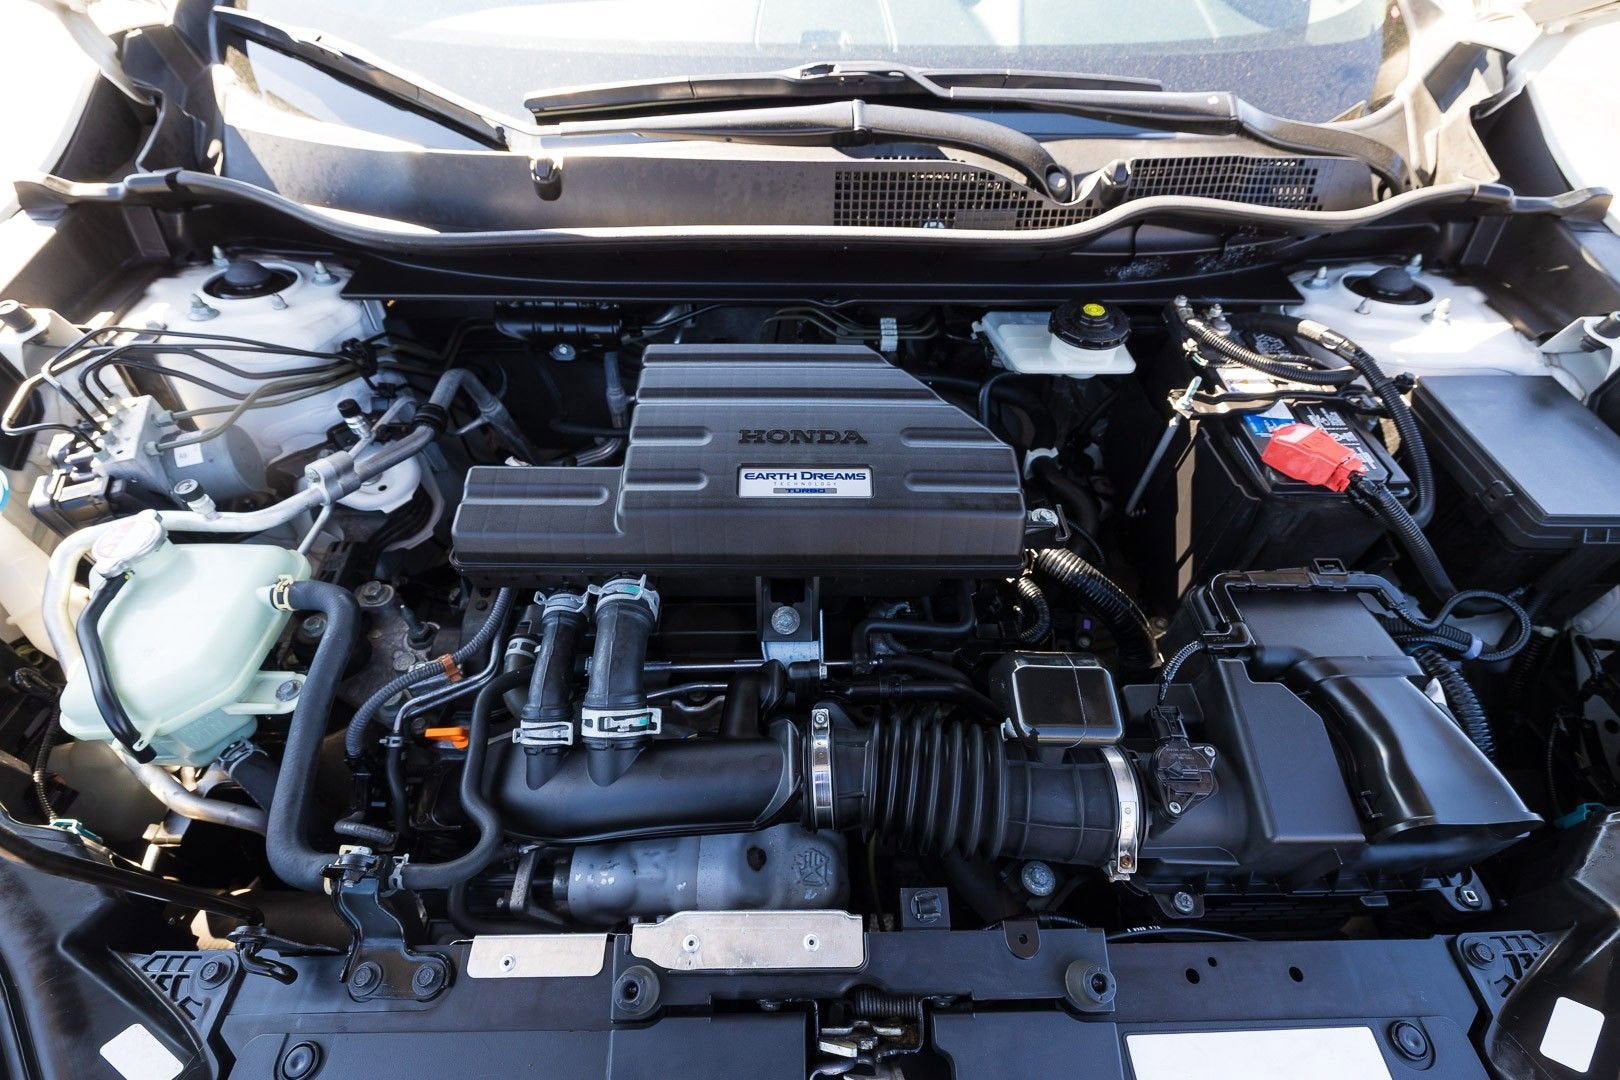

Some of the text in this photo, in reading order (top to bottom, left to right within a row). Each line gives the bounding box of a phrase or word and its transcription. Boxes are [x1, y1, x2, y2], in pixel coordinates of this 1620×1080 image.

[738, 429, 868, 444] HONDA
[744, 471, 866, 480] EARTH DREAMS
